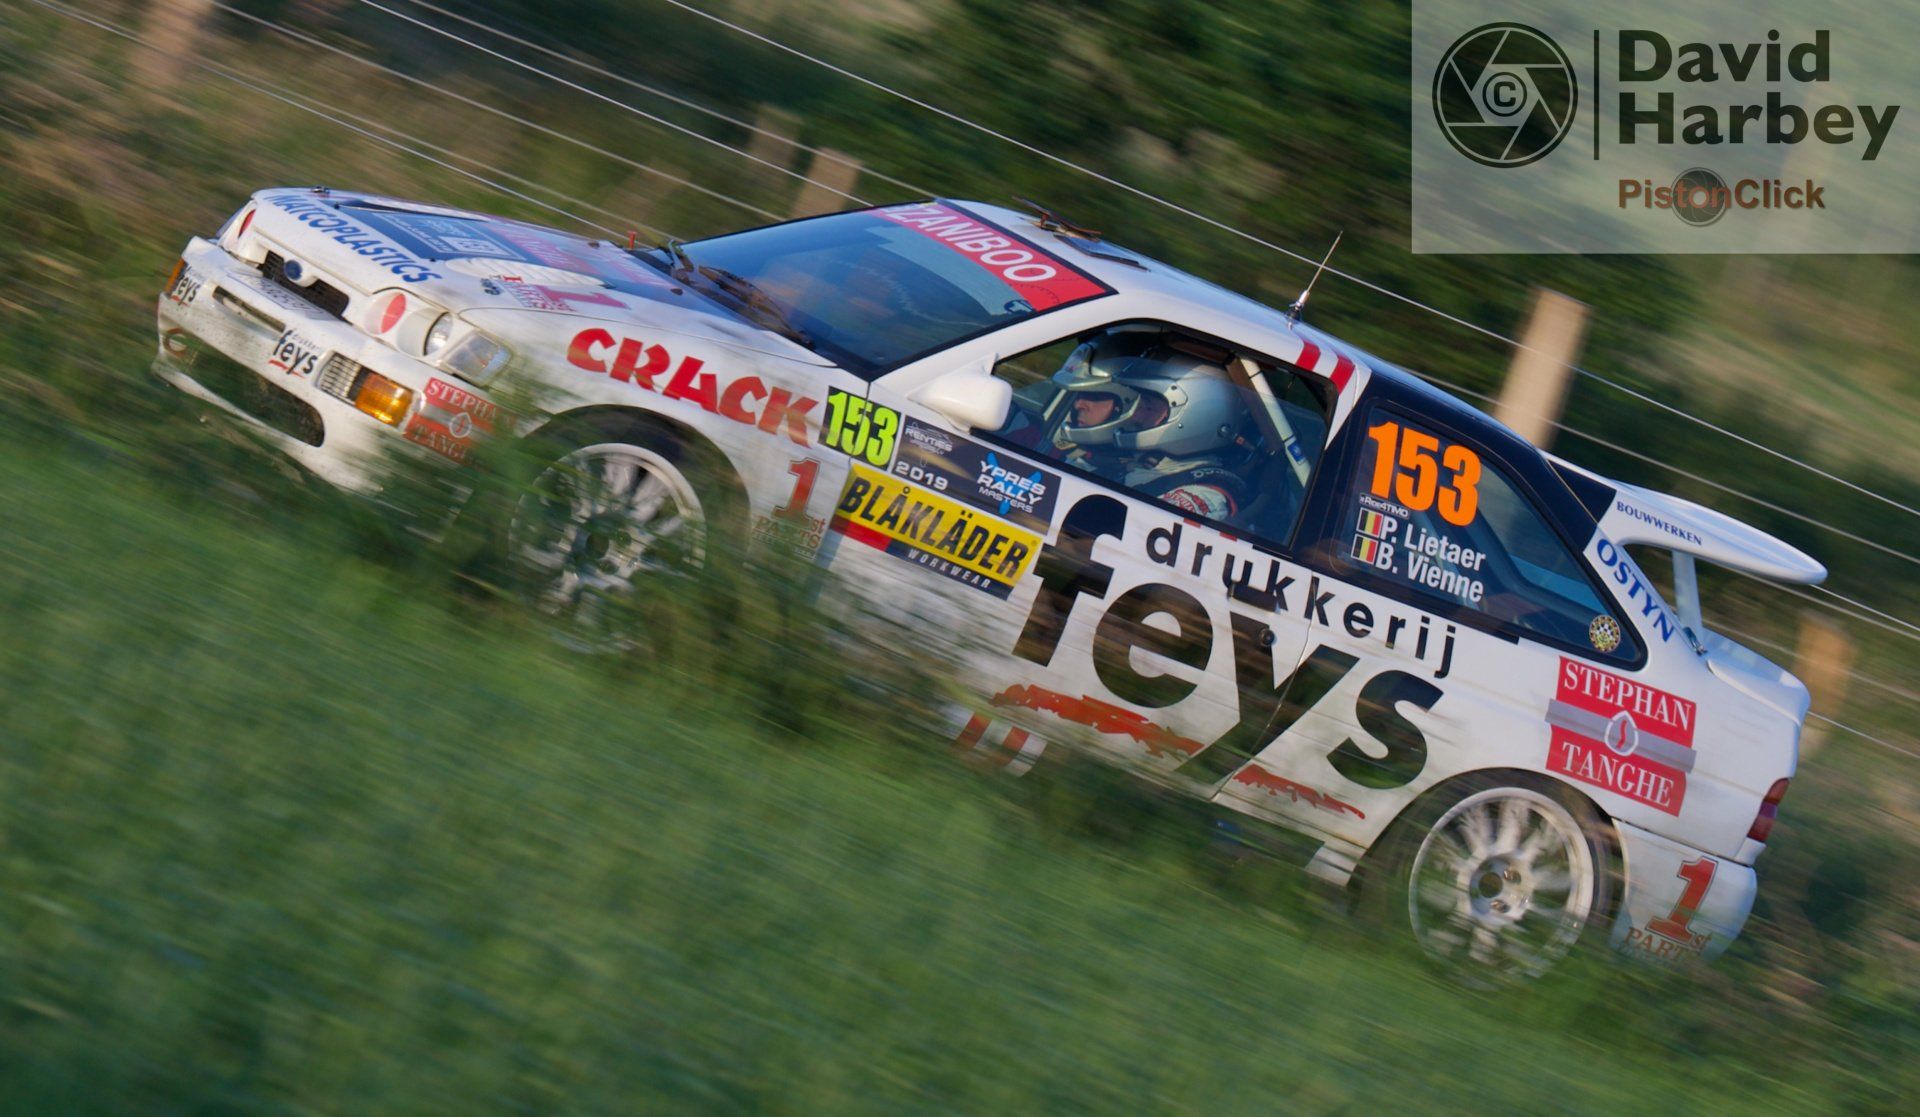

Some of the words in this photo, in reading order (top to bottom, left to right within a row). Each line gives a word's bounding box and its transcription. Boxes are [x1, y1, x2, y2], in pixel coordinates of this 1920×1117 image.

[272, 328, 318, 376] feys
[428, 378, 518, 428] STEPHA
[566, 327, 819, 450] CRACK
[824, 390, 899, 467] 153
[895, 460, 949, 491] 2019
[976, 473, 1043, 505] RALLY
[978, 486, 1034, 514] MASTERS
[979, 459, 1047, 496] YPRES
[1368, 421, 1482, 527] 153
[838, 477, 1031, 580] BLÅKLÄDER
[1380, 516, 1398, 543] P.
[1404, 523, 1486, 571] Lietaer
[1615, 501, 1702, 546] BOUWWERKEN
[907, 548, 993, 589] WORKWEAR
[1375, 541, 1398, 574] B.
[1407, 551, 1484, 603] Vienne
[1595, 538, 1675, 643] OSTYN
[1145, 521, 1457, 679] drukkerij
[1011, 493, 1445, 789] feys
[1563, 661, 1692, 732] STEPHAN
[1562, 741, 1674, 808] TANGHE
